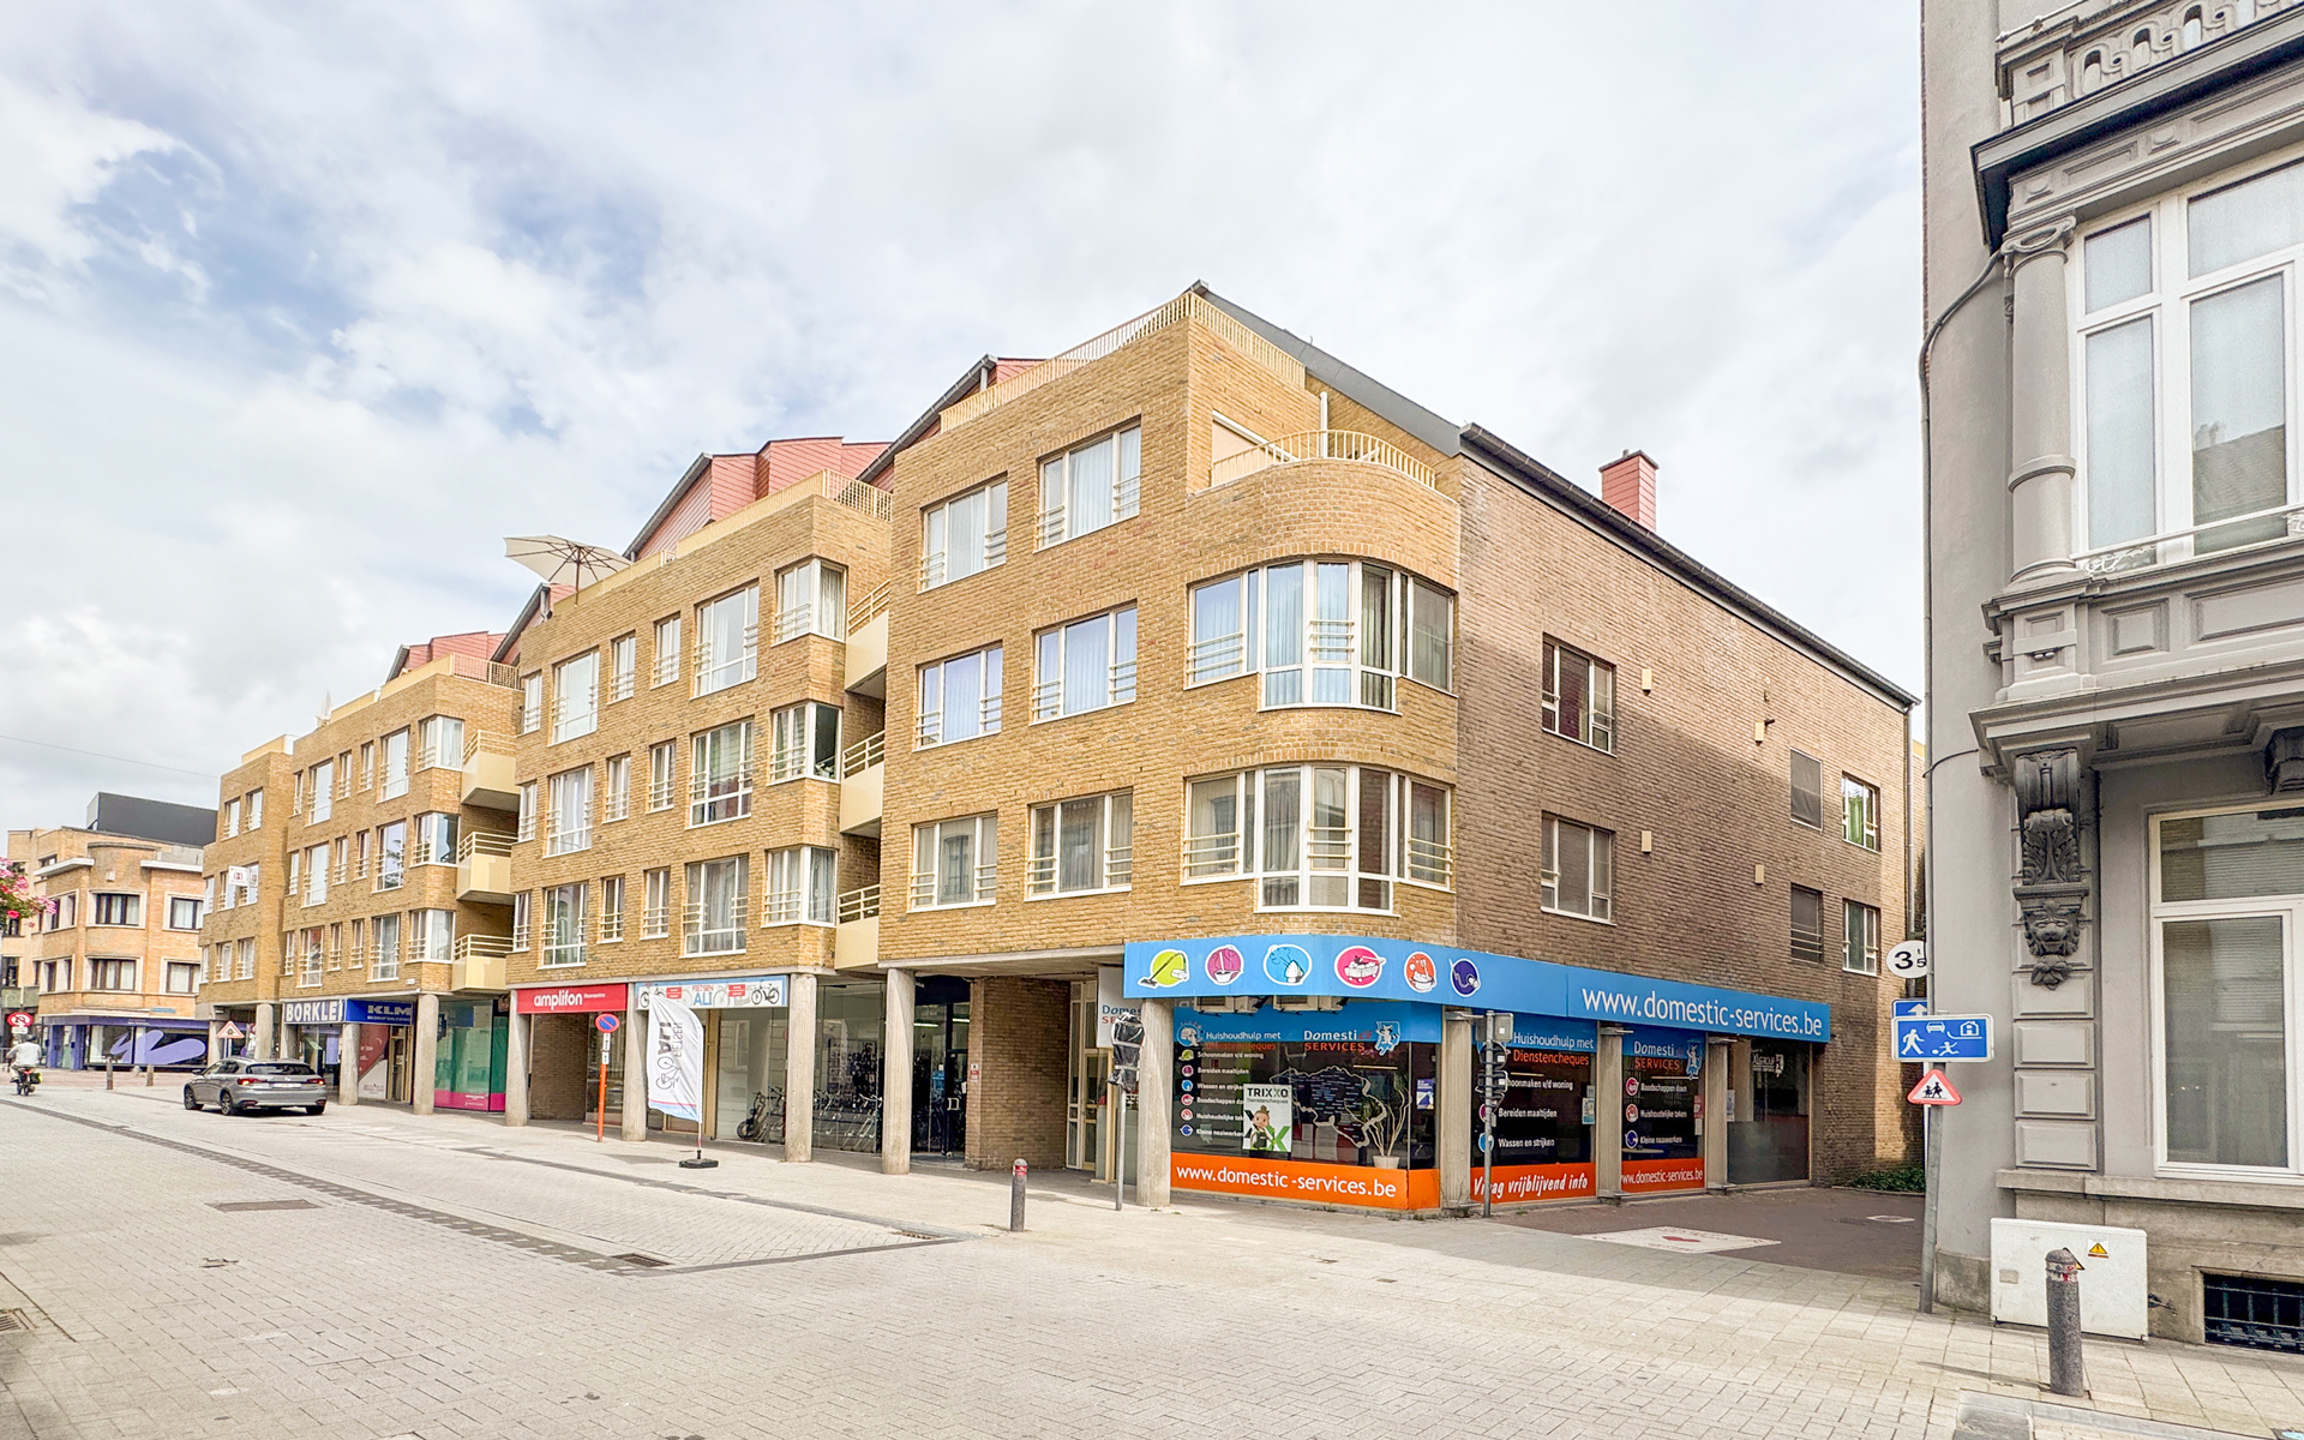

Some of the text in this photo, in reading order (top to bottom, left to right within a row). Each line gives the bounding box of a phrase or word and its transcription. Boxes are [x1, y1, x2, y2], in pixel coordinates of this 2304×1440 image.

[692, 984, 714, 992] FIETSEN
[533, 989, 583, 1011] amplifon
[693, 991, 713, 1006] ALI
[367, 1004, 413, 1016] KLM
[1582, 988, 1823, 1036] www.domestic-services.be
[1205, 1031, 1281, 1041] Huishoudhulp met
[1513, 1031, 1595, 1050] Huishoudhulp met
[1304, 1042, 1366, 1052] SERVICES
[1513, 1049, 1590, 1067] Dienstencheques
[1634, 1057, 1681, 1070] SERVICES
[1507, 1078, 1542, 1088] hoonmaken
[1552, 1080, 1574, 1091] woning
[1246, 1087, 1289, 1098] TRIXXO
[1498, 1107, 1558, 1119] Bereiden maaltijden
[1498, 1137, 1555, 1149] Wassen en strijken
[1507, 1173, 1567, 1198] vrijblijvend
[1568, 1172, 1589, 1190] info
